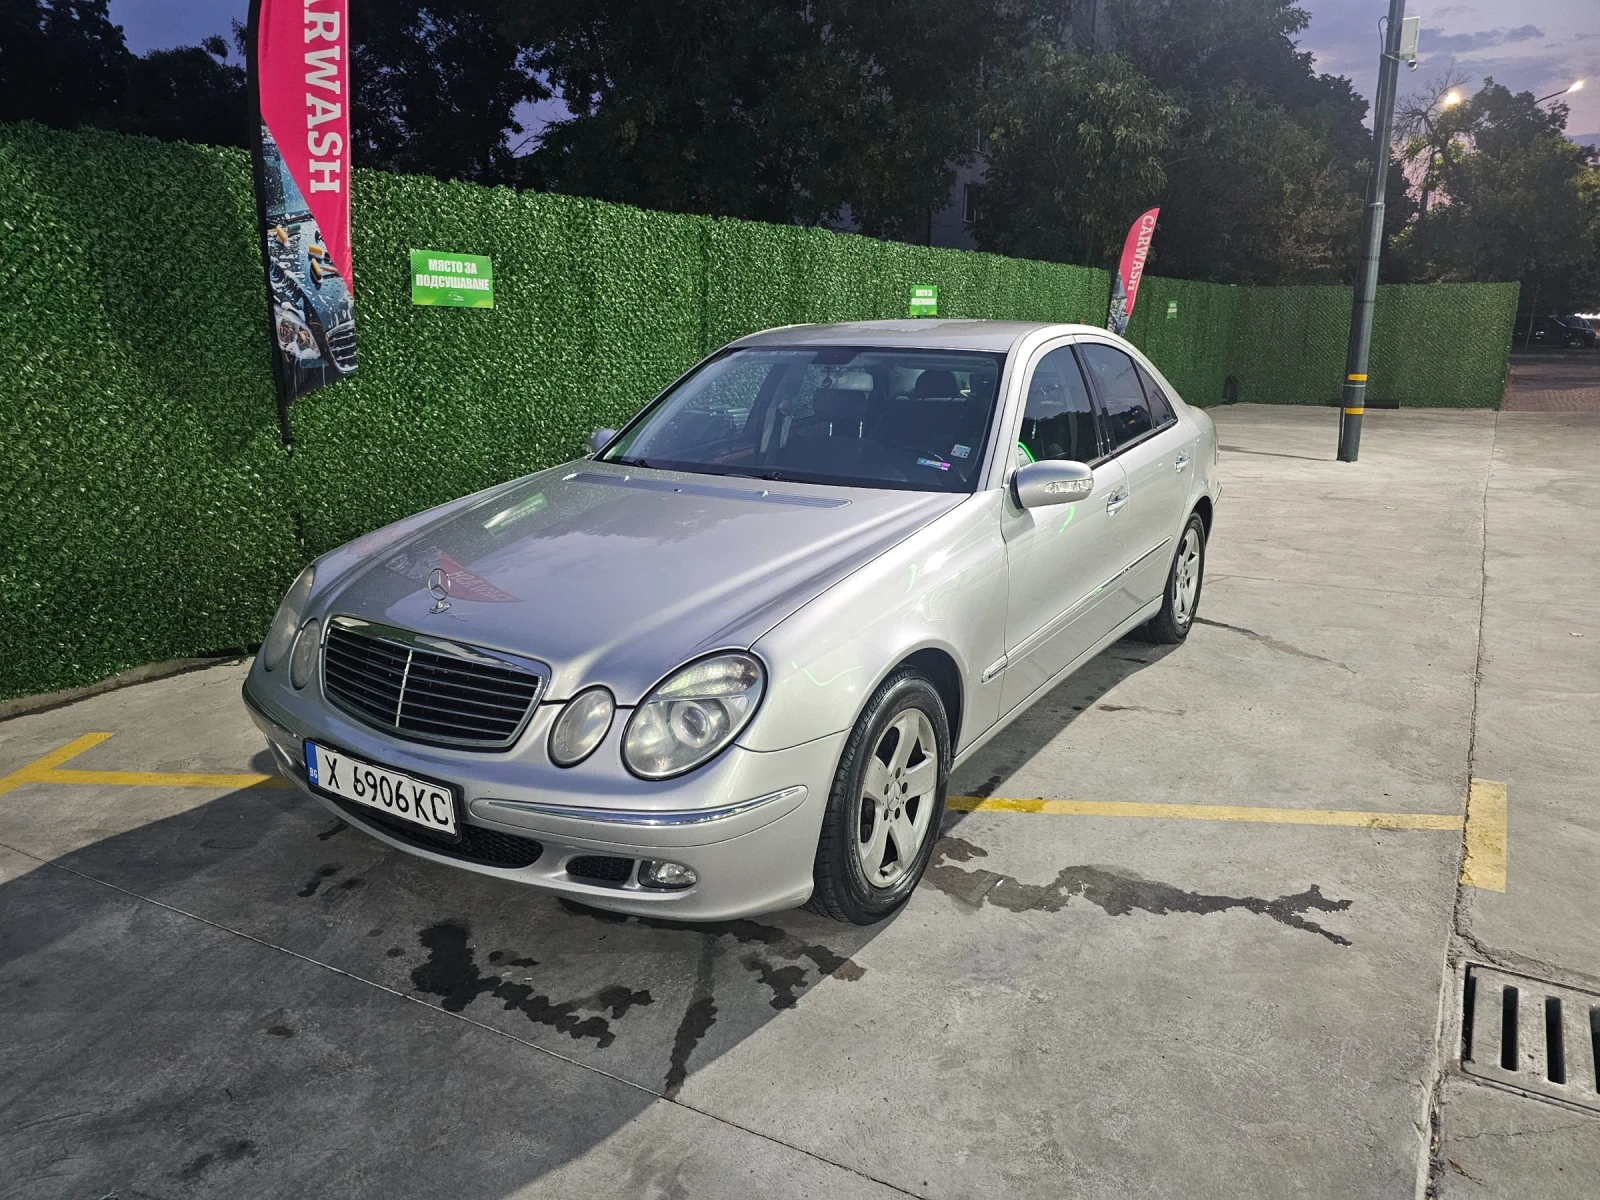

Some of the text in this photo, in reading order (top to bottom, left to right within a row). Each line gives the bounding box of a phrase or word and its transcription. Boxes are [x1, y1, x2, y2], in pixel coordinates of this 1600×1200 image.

[304, 0, 344, 193] RWASH
[428, 258, 478, 275] МЯСТО ЗА
[1127, 215, 1155, 291] CARWASH
[415, 273, 490, 291] ПОДСУШАВАНЕ
[309, 767, 319, 779] BG
[324, 754, 449, 826] X 6906KC
